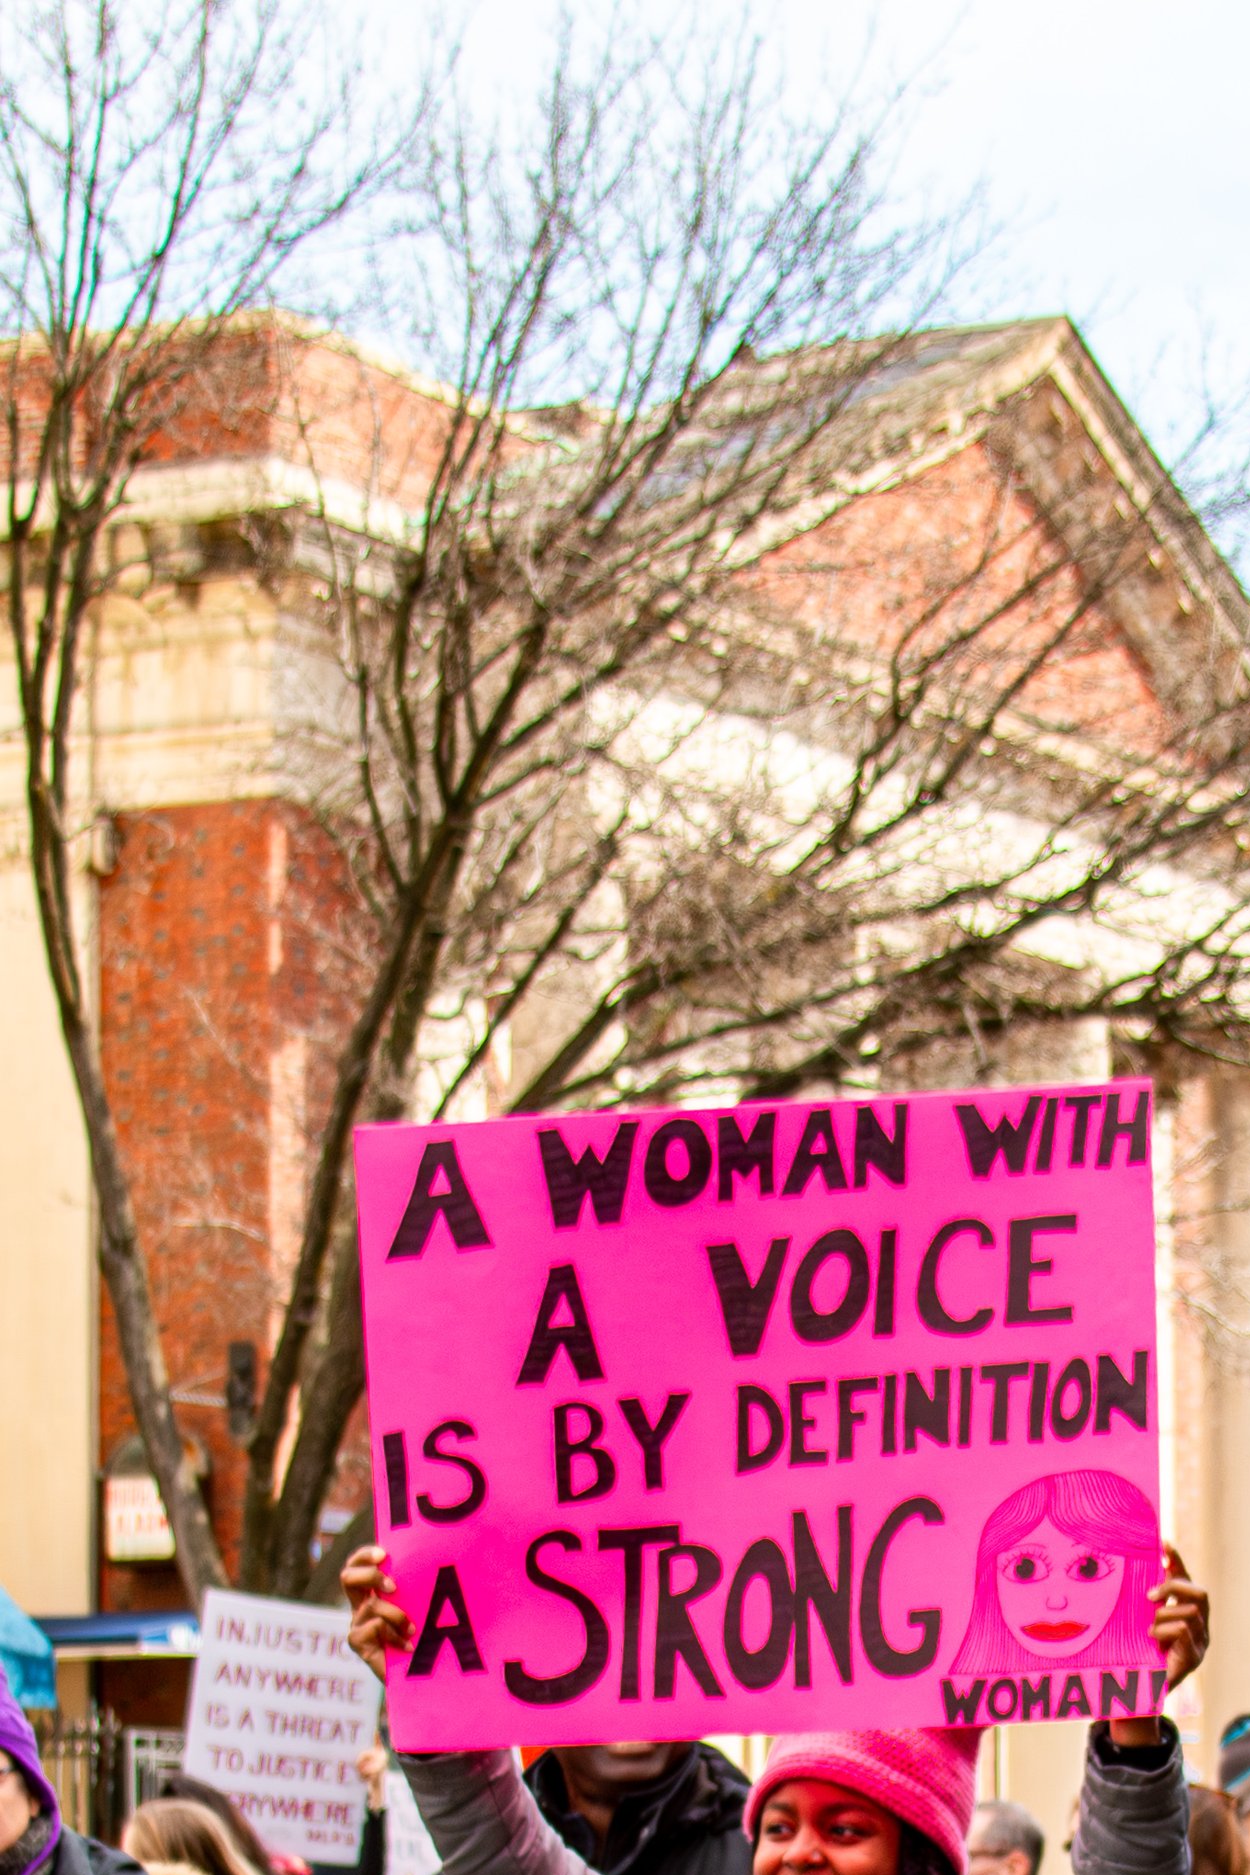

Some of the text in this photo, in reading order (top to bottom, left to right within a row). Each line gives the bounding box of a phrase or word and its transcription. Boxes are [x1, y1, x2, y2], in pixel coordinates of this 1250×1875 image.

[387, 1091, 1149, 1259] A WOMAN WITH
[517, 1214, 1077, 1385] A VOICE
[382, 1350, 1148, 1527] IS BY DEFINITION
[403, 1496, 943, 1705] A STRONG
[205, 1701, 363, 1744] IS A THREAT
[215, 1662, 366, 1704] ANYWHERE
[942, 1669, 1167, 1725] WOMAN!
[208, 1744, 243, 1771] TO
